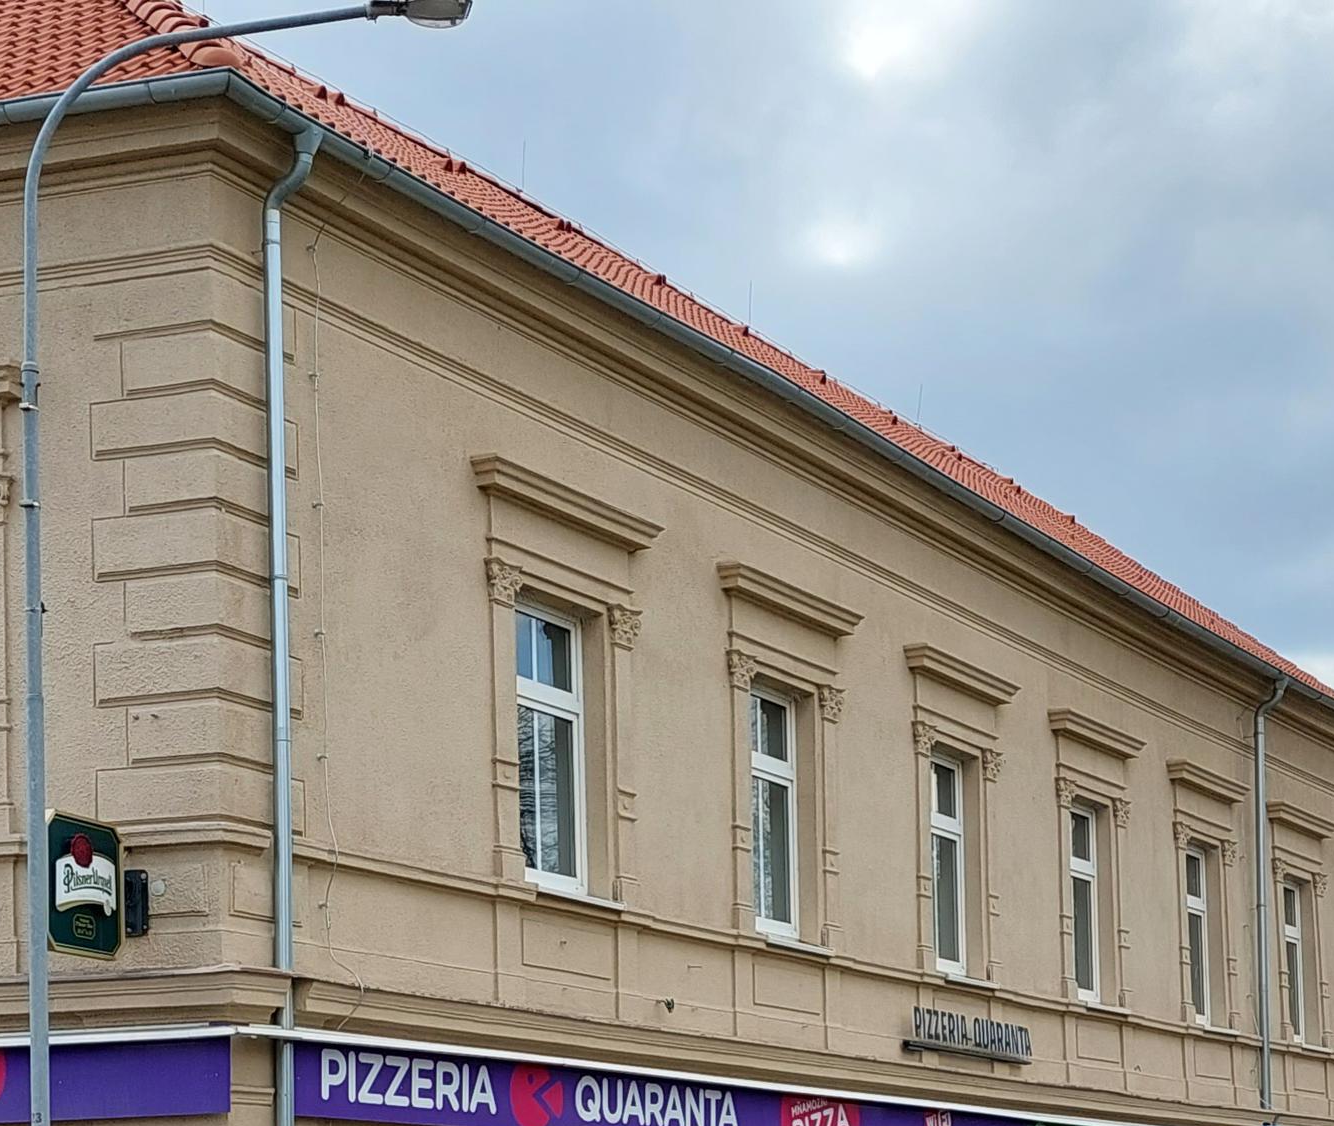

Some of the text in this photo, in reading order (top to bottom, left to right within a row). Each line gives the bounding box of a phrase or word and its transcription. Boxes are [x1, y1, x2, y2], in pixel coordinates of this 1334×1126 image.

[63, 863, 93, 893] Pilsner
[913, 1006, 1032, 1057] PIZZERIA QUARANTA
[319, 1048, 498, 1116] PIZZERIA
